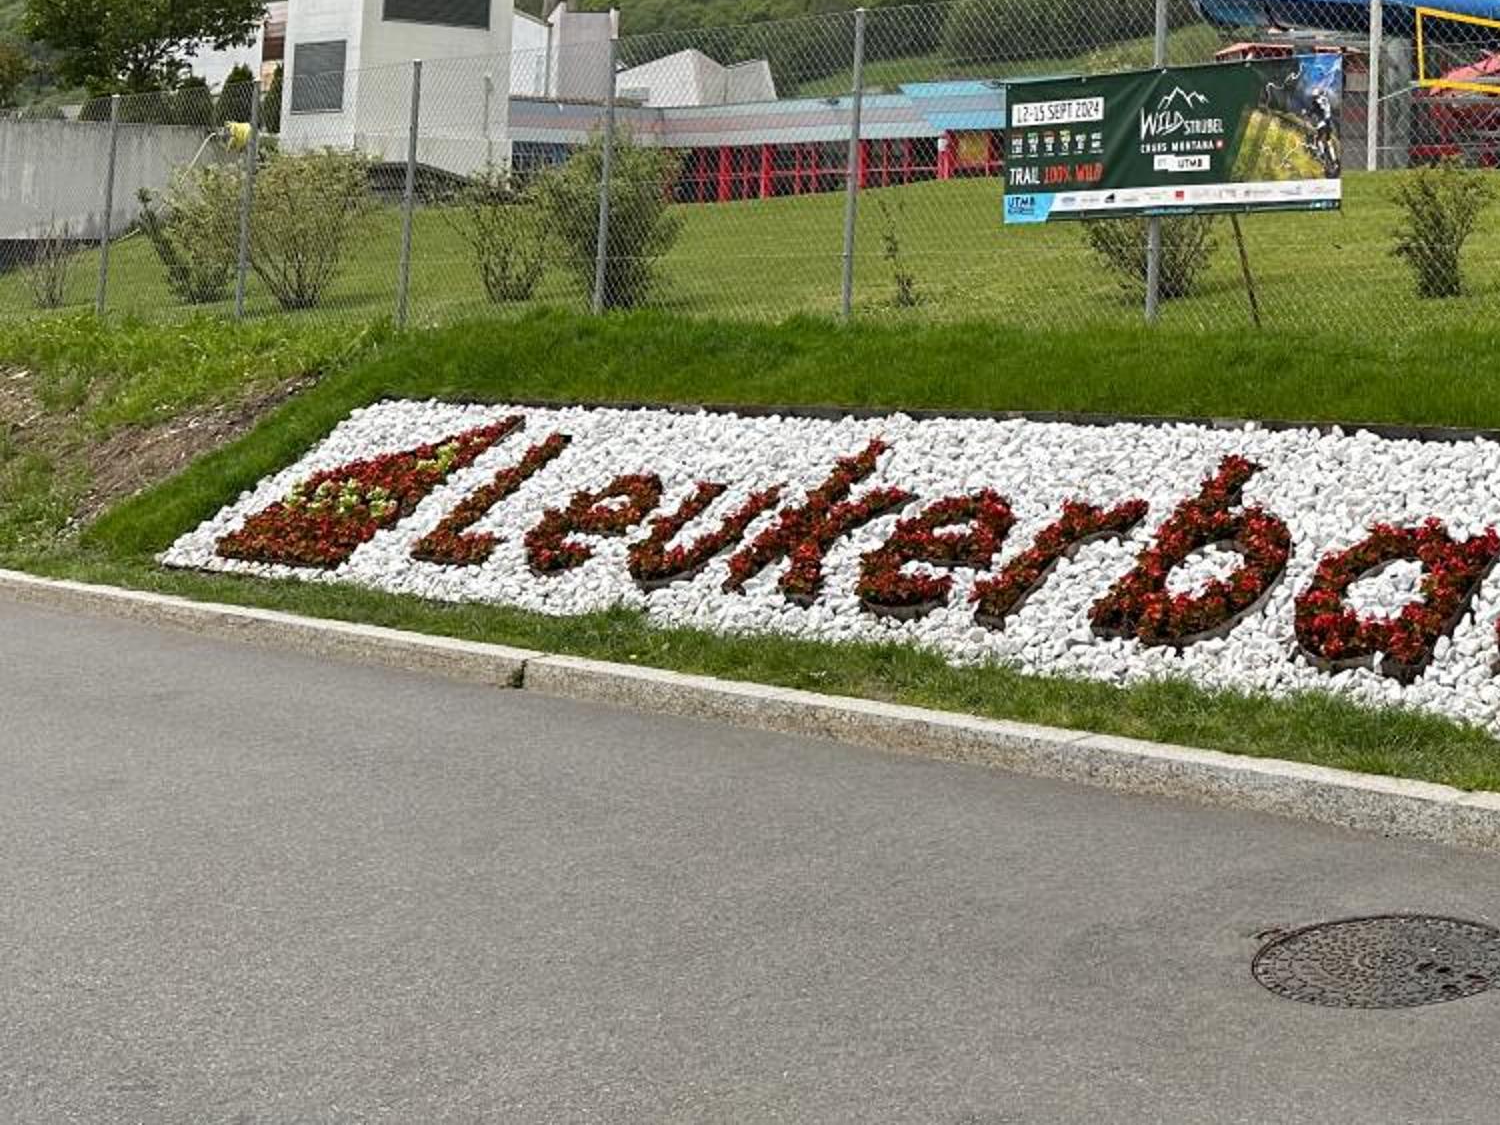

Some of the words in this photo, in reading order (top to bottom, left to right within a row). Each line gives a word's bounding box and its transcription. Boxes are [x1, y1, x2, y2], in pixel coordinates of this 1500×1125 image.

[1017, 104, 1045, 123] 12-15
[1047, 102, 1073, 120] SEPT
[1075, 100, 1100, 118] 2024
[1141, 106, 1185, 140] WILD
[1009, 166, 1041, 186] TRAIL
[1075, 162, 1104, 182] WILD
[1009, 196, 1036, 207] UTMB
